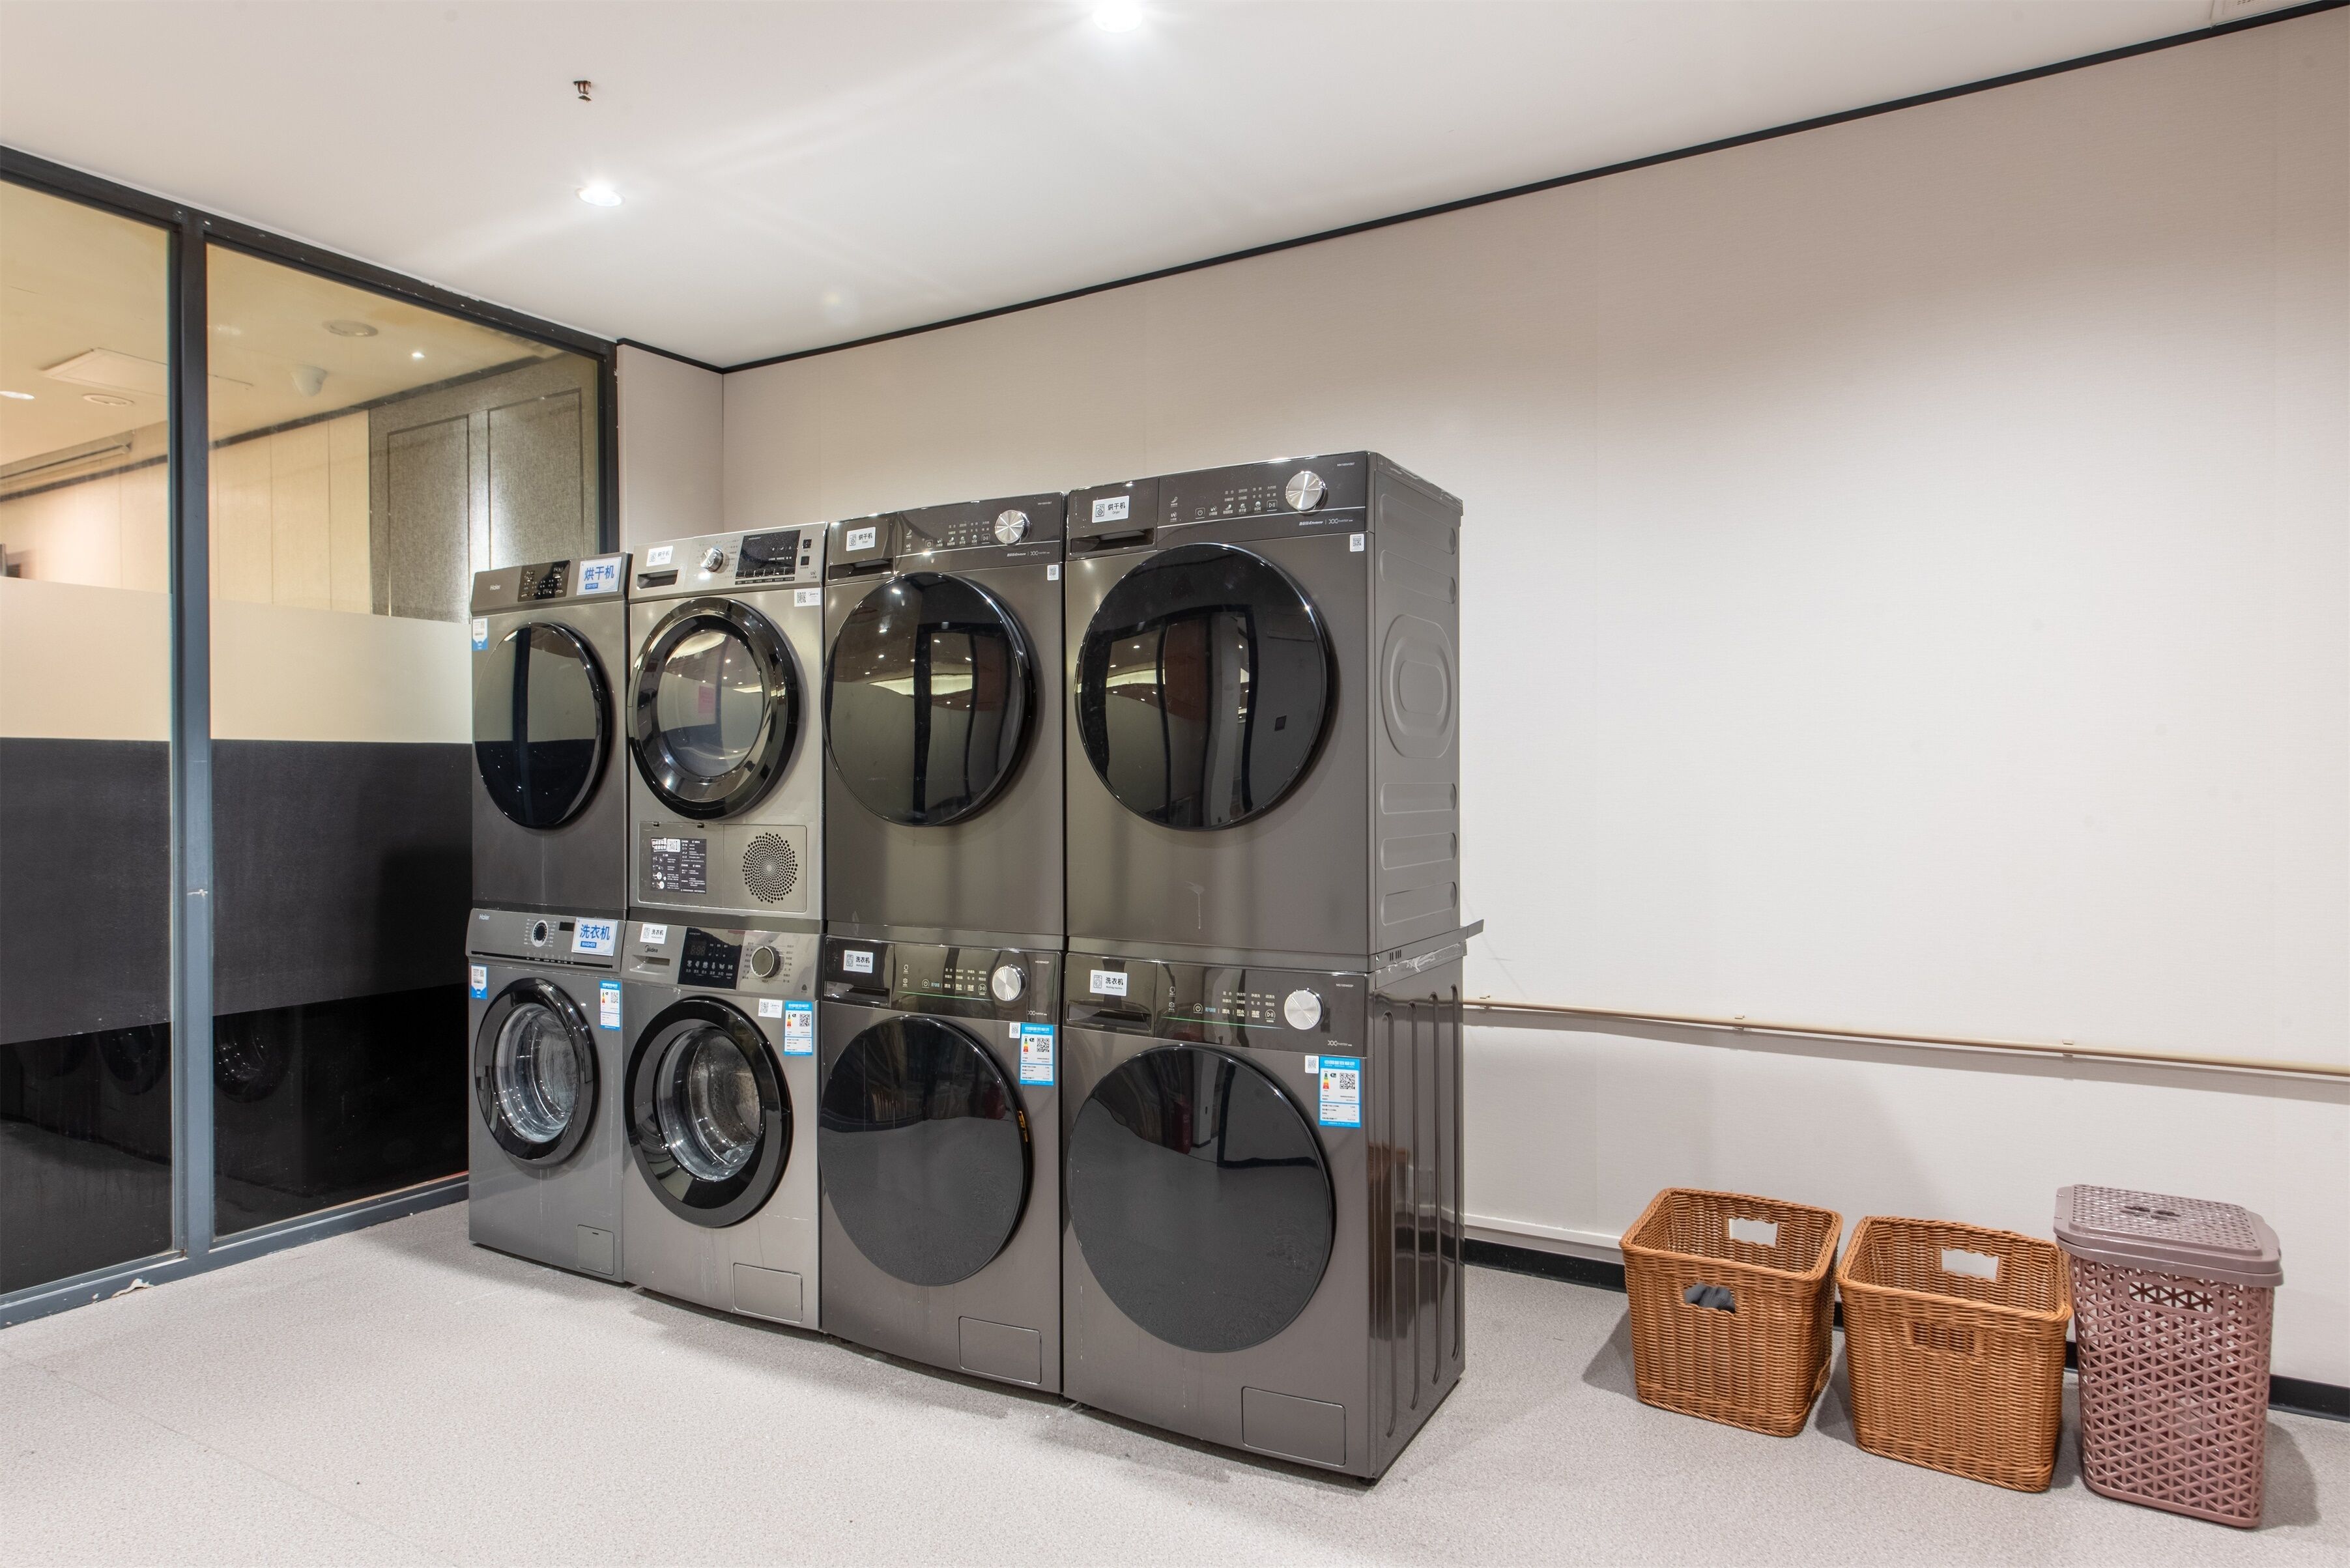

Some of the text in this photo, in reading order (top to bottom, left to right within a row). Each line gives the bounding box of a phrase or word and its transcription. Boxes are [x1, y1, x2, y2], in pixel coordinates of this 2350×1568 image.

[1108, 502, 1126, 511] 烘干机
[859, 532, 872, 541] 烘干机
[584, 565, 614, 581] 烘干机
[579, 924, 610, 941] 洗衣机
[1105, 976, 1124, 986] 洗衣机
